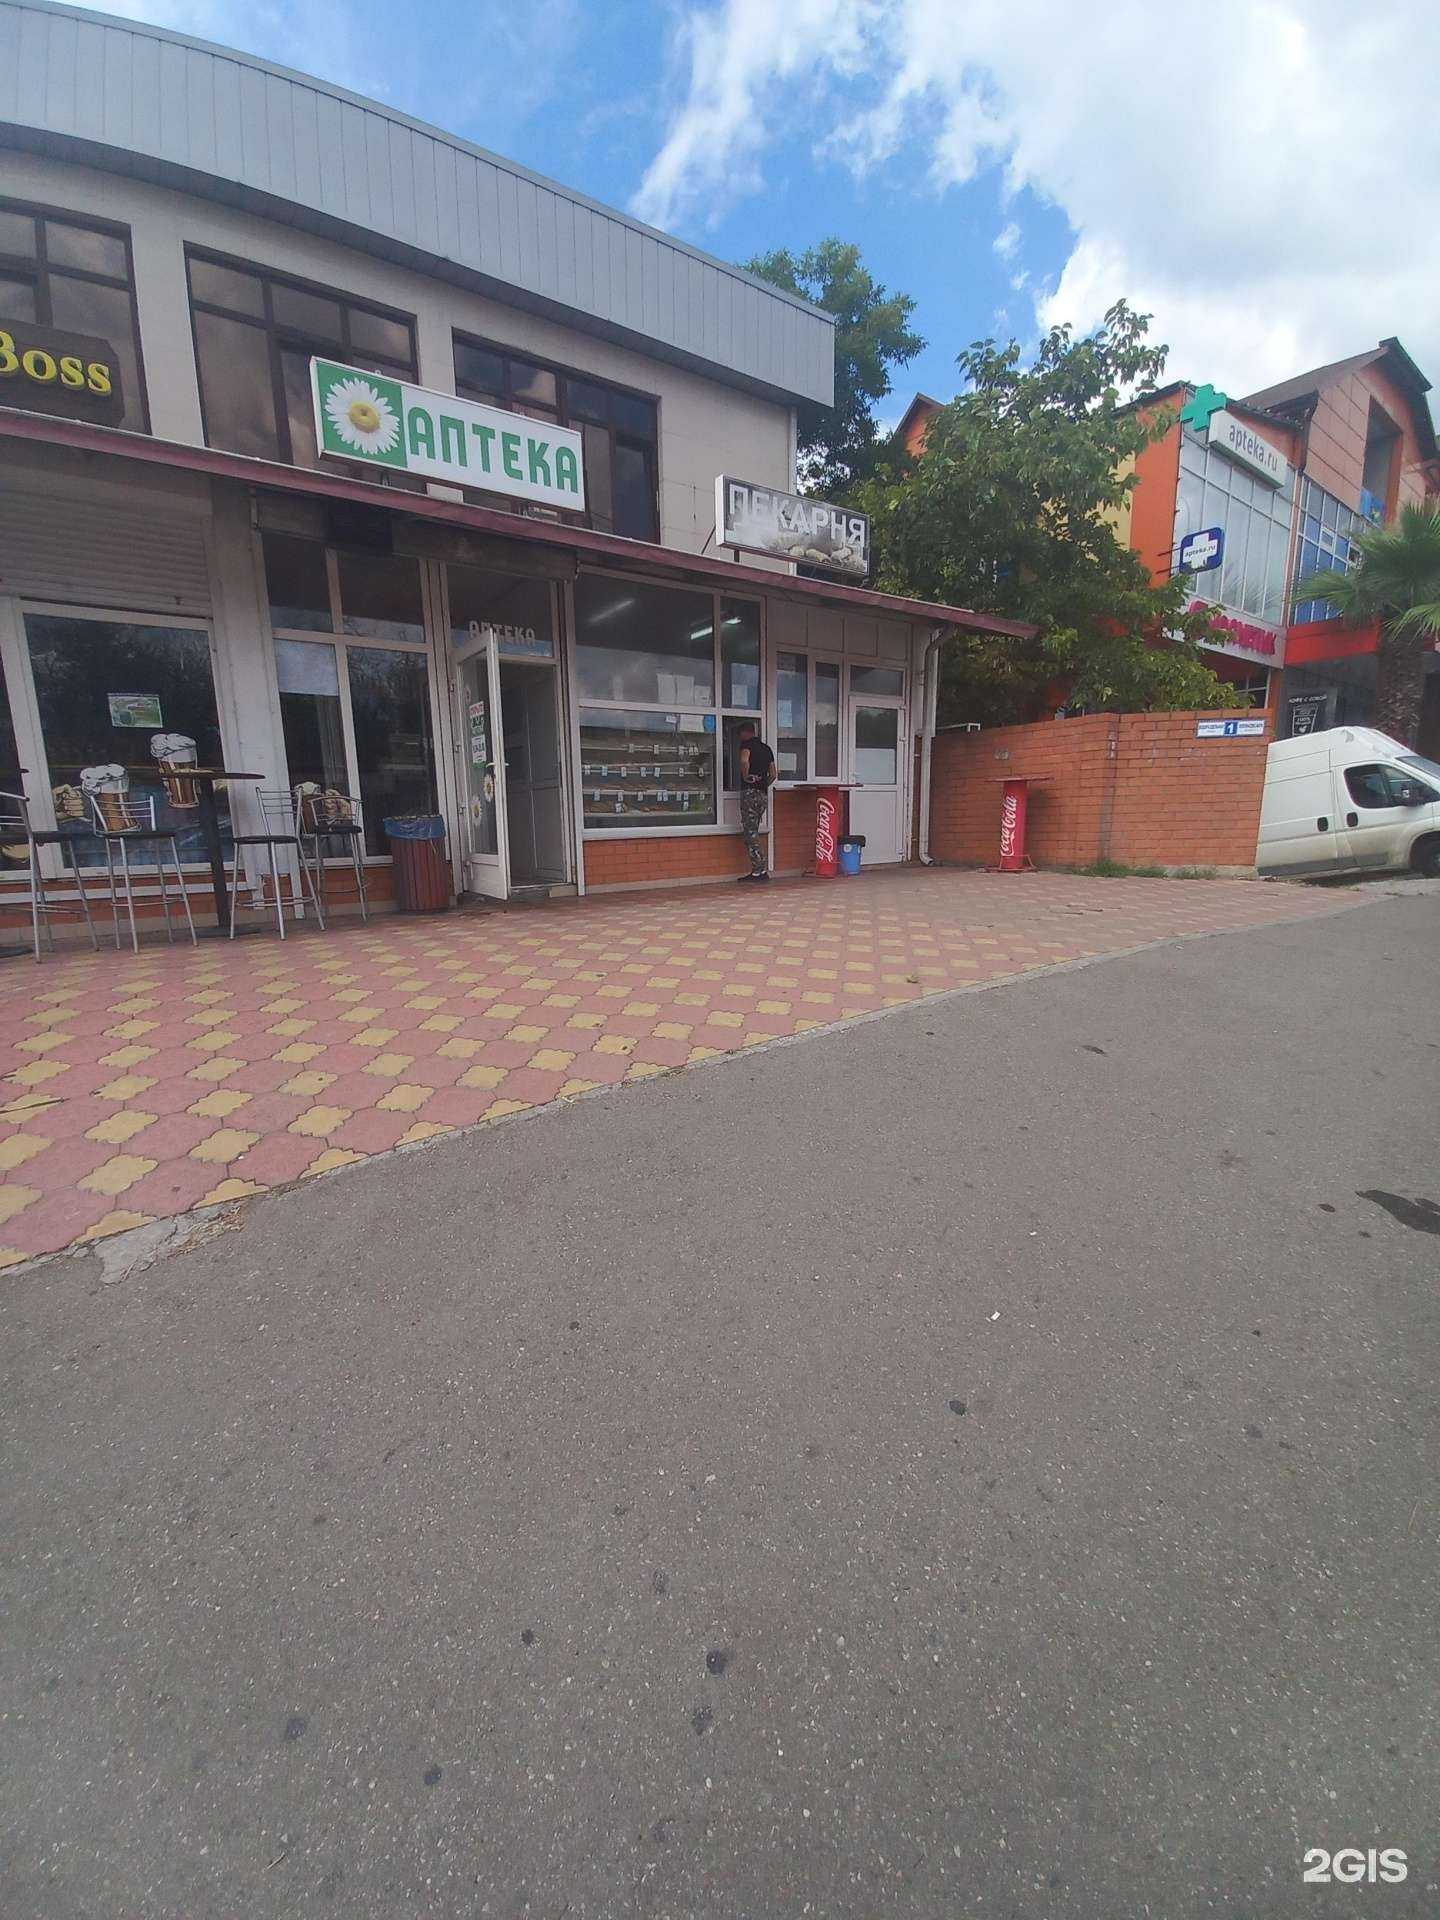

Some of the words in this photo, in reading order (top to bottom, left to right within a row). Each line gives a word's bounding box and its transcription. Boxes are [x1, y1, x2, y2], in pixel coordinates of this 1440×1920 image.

[407, 406, 579, 494] АПТЕКА
[1229, 425, 1278, 472] apteka.ru
[729, 483, 865, 557] ПЕКАРНЯ
